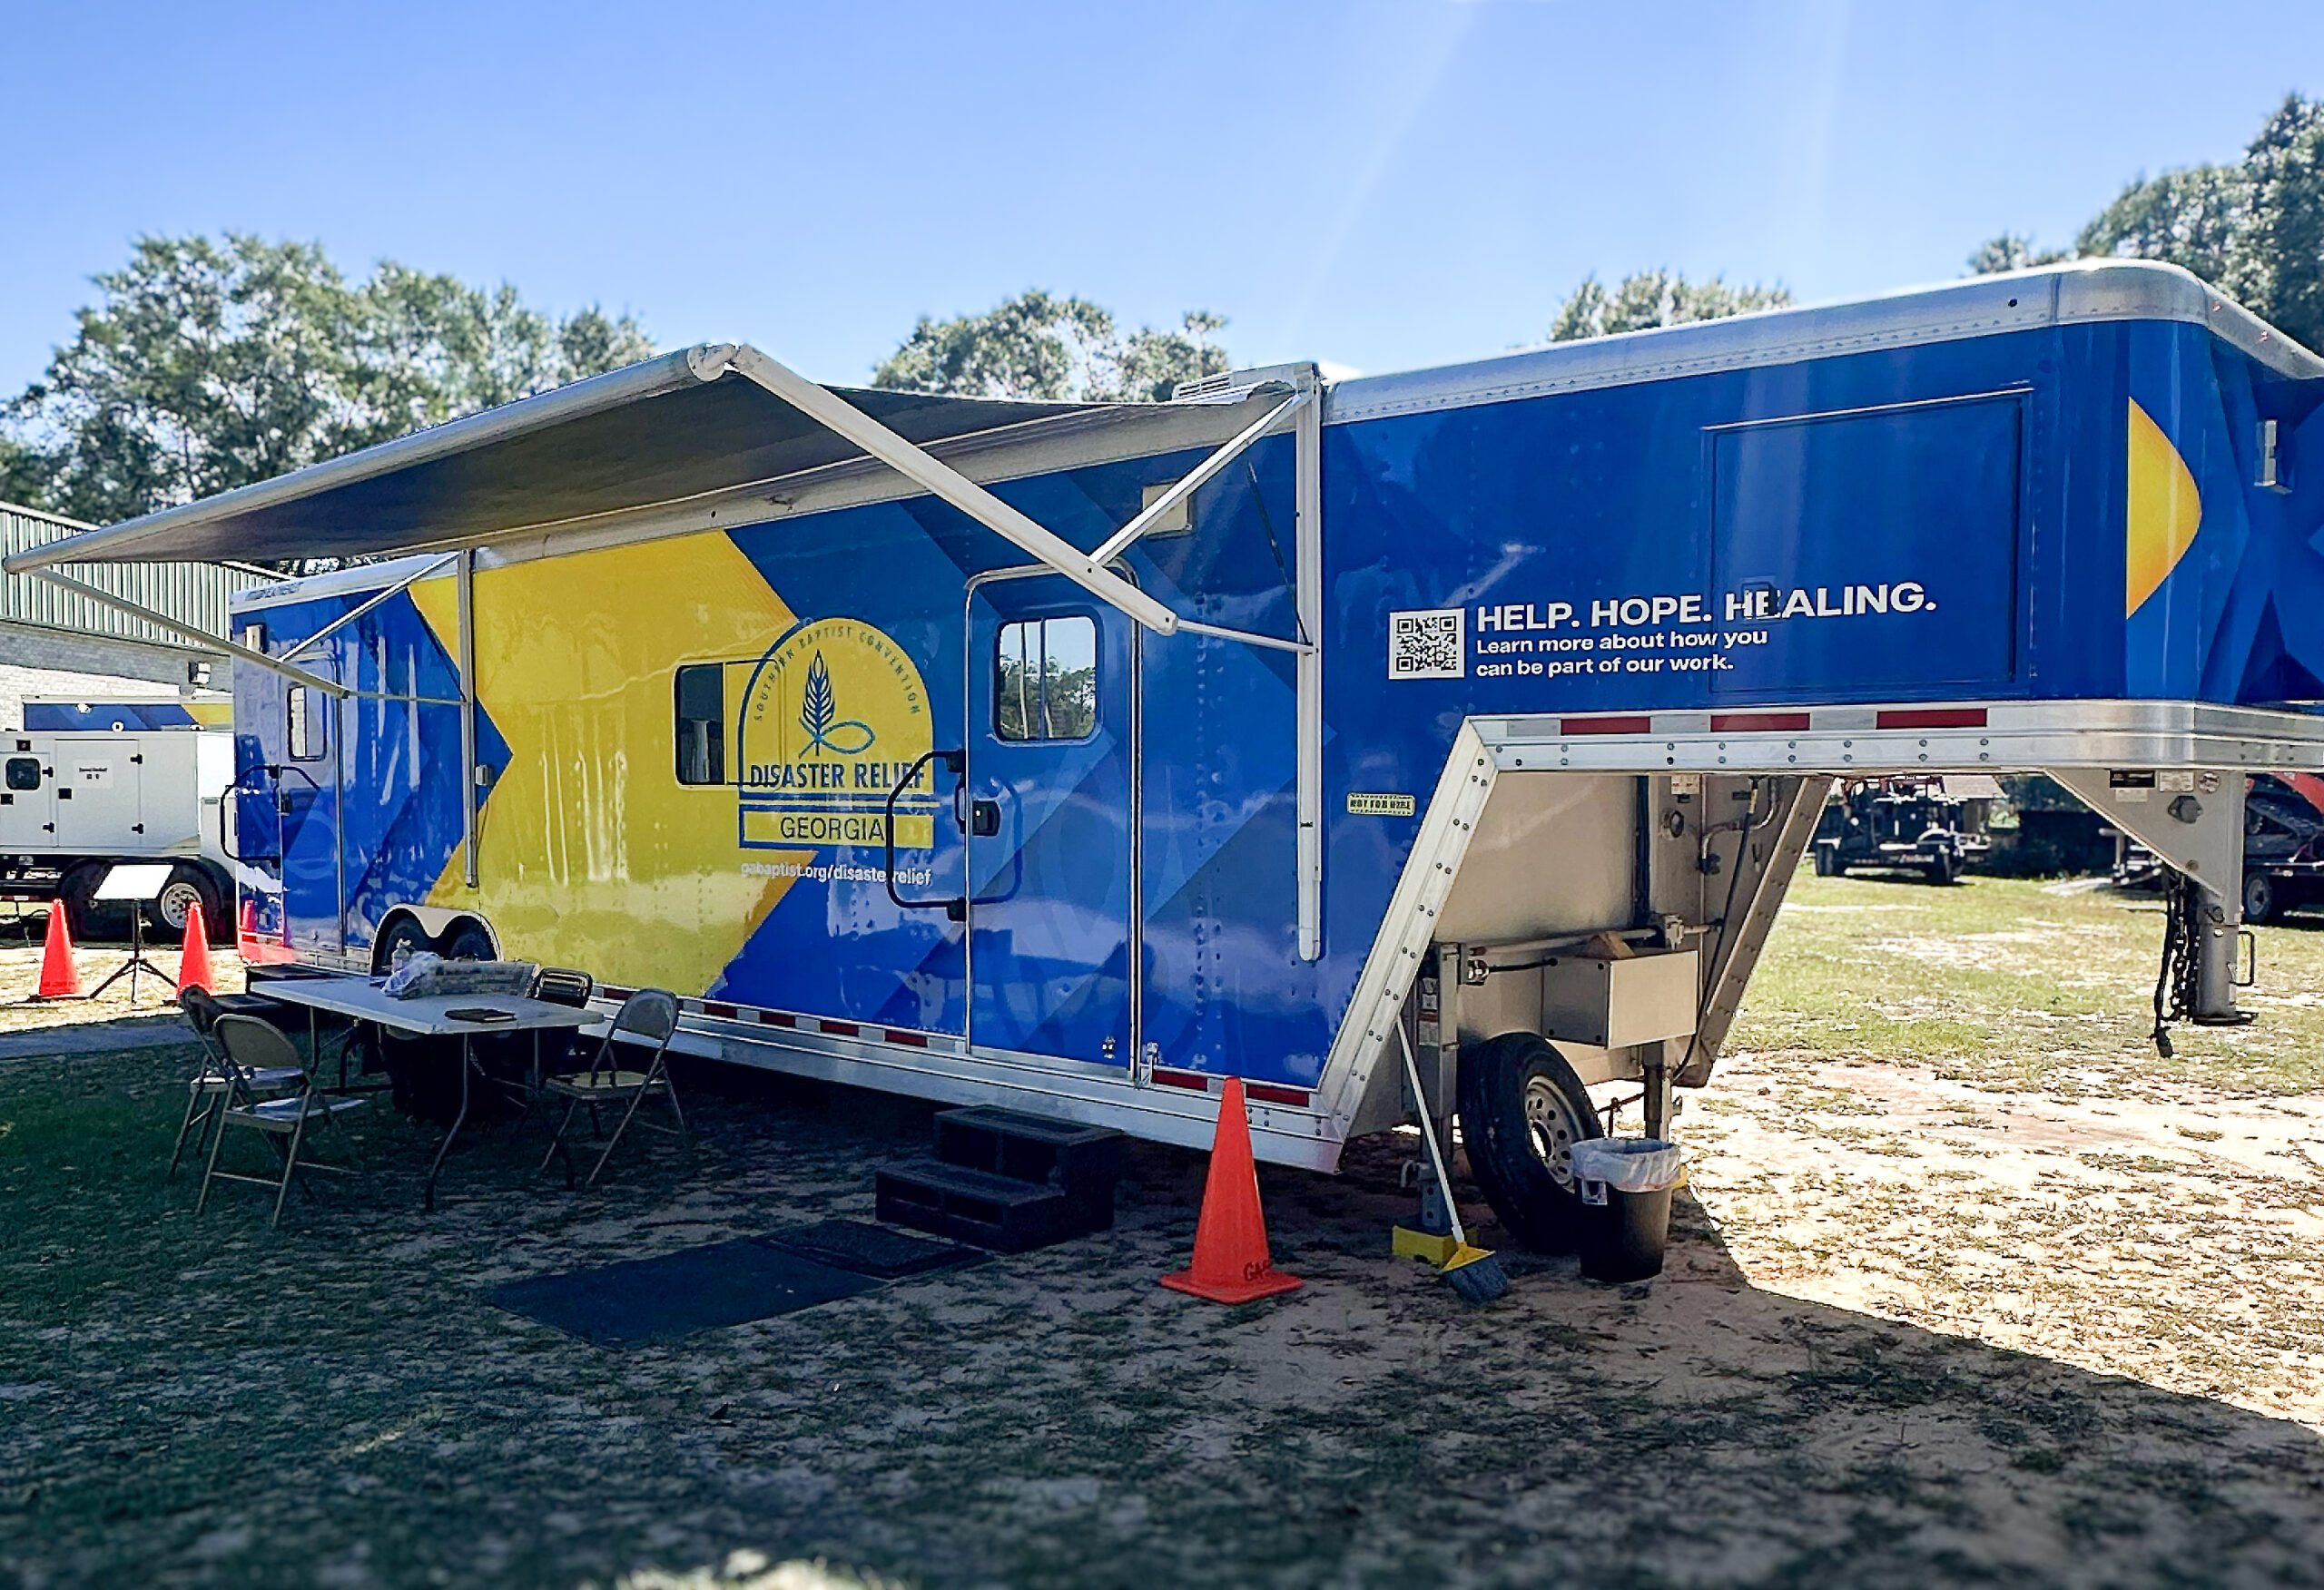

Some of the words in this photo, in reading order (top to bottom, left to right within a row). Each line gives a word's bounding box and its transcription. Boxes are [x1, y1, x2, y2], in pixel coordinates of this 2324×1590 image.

[1477, 603, 1581, 633] HELP.
[1590, 594, 1712, 627] HOPE.
[1725, 581, 1937, 621] HEALING.
[1477, 639, 1533, 654] Learn
[1539, 637, 1594, 652] more
[1599, 633, 1665, 649] about
[1670, 632, 1717, 648] how
[1723, 631, 1768, 649] you
[798, 626, 852, 649] BAPTIST
[860, 631, 921, 714] CONVENTION
[1476, 662, 1513, 677] can
[1517, 659, 1543, 675] be
[1549, 658, 1594, 678] part
[1599, 657, 1621, 673] of
[1626, 659, 1665, 672] our
[1669, 654, 1735, 672] work.
[750, 762, 845, 789] DISASTER
[854, 762, 925, 789] RELIEF
[781, 817, 885, 841] GEORGIA
[741, 861, 931, 885] gabaptist.org/disasterelief
